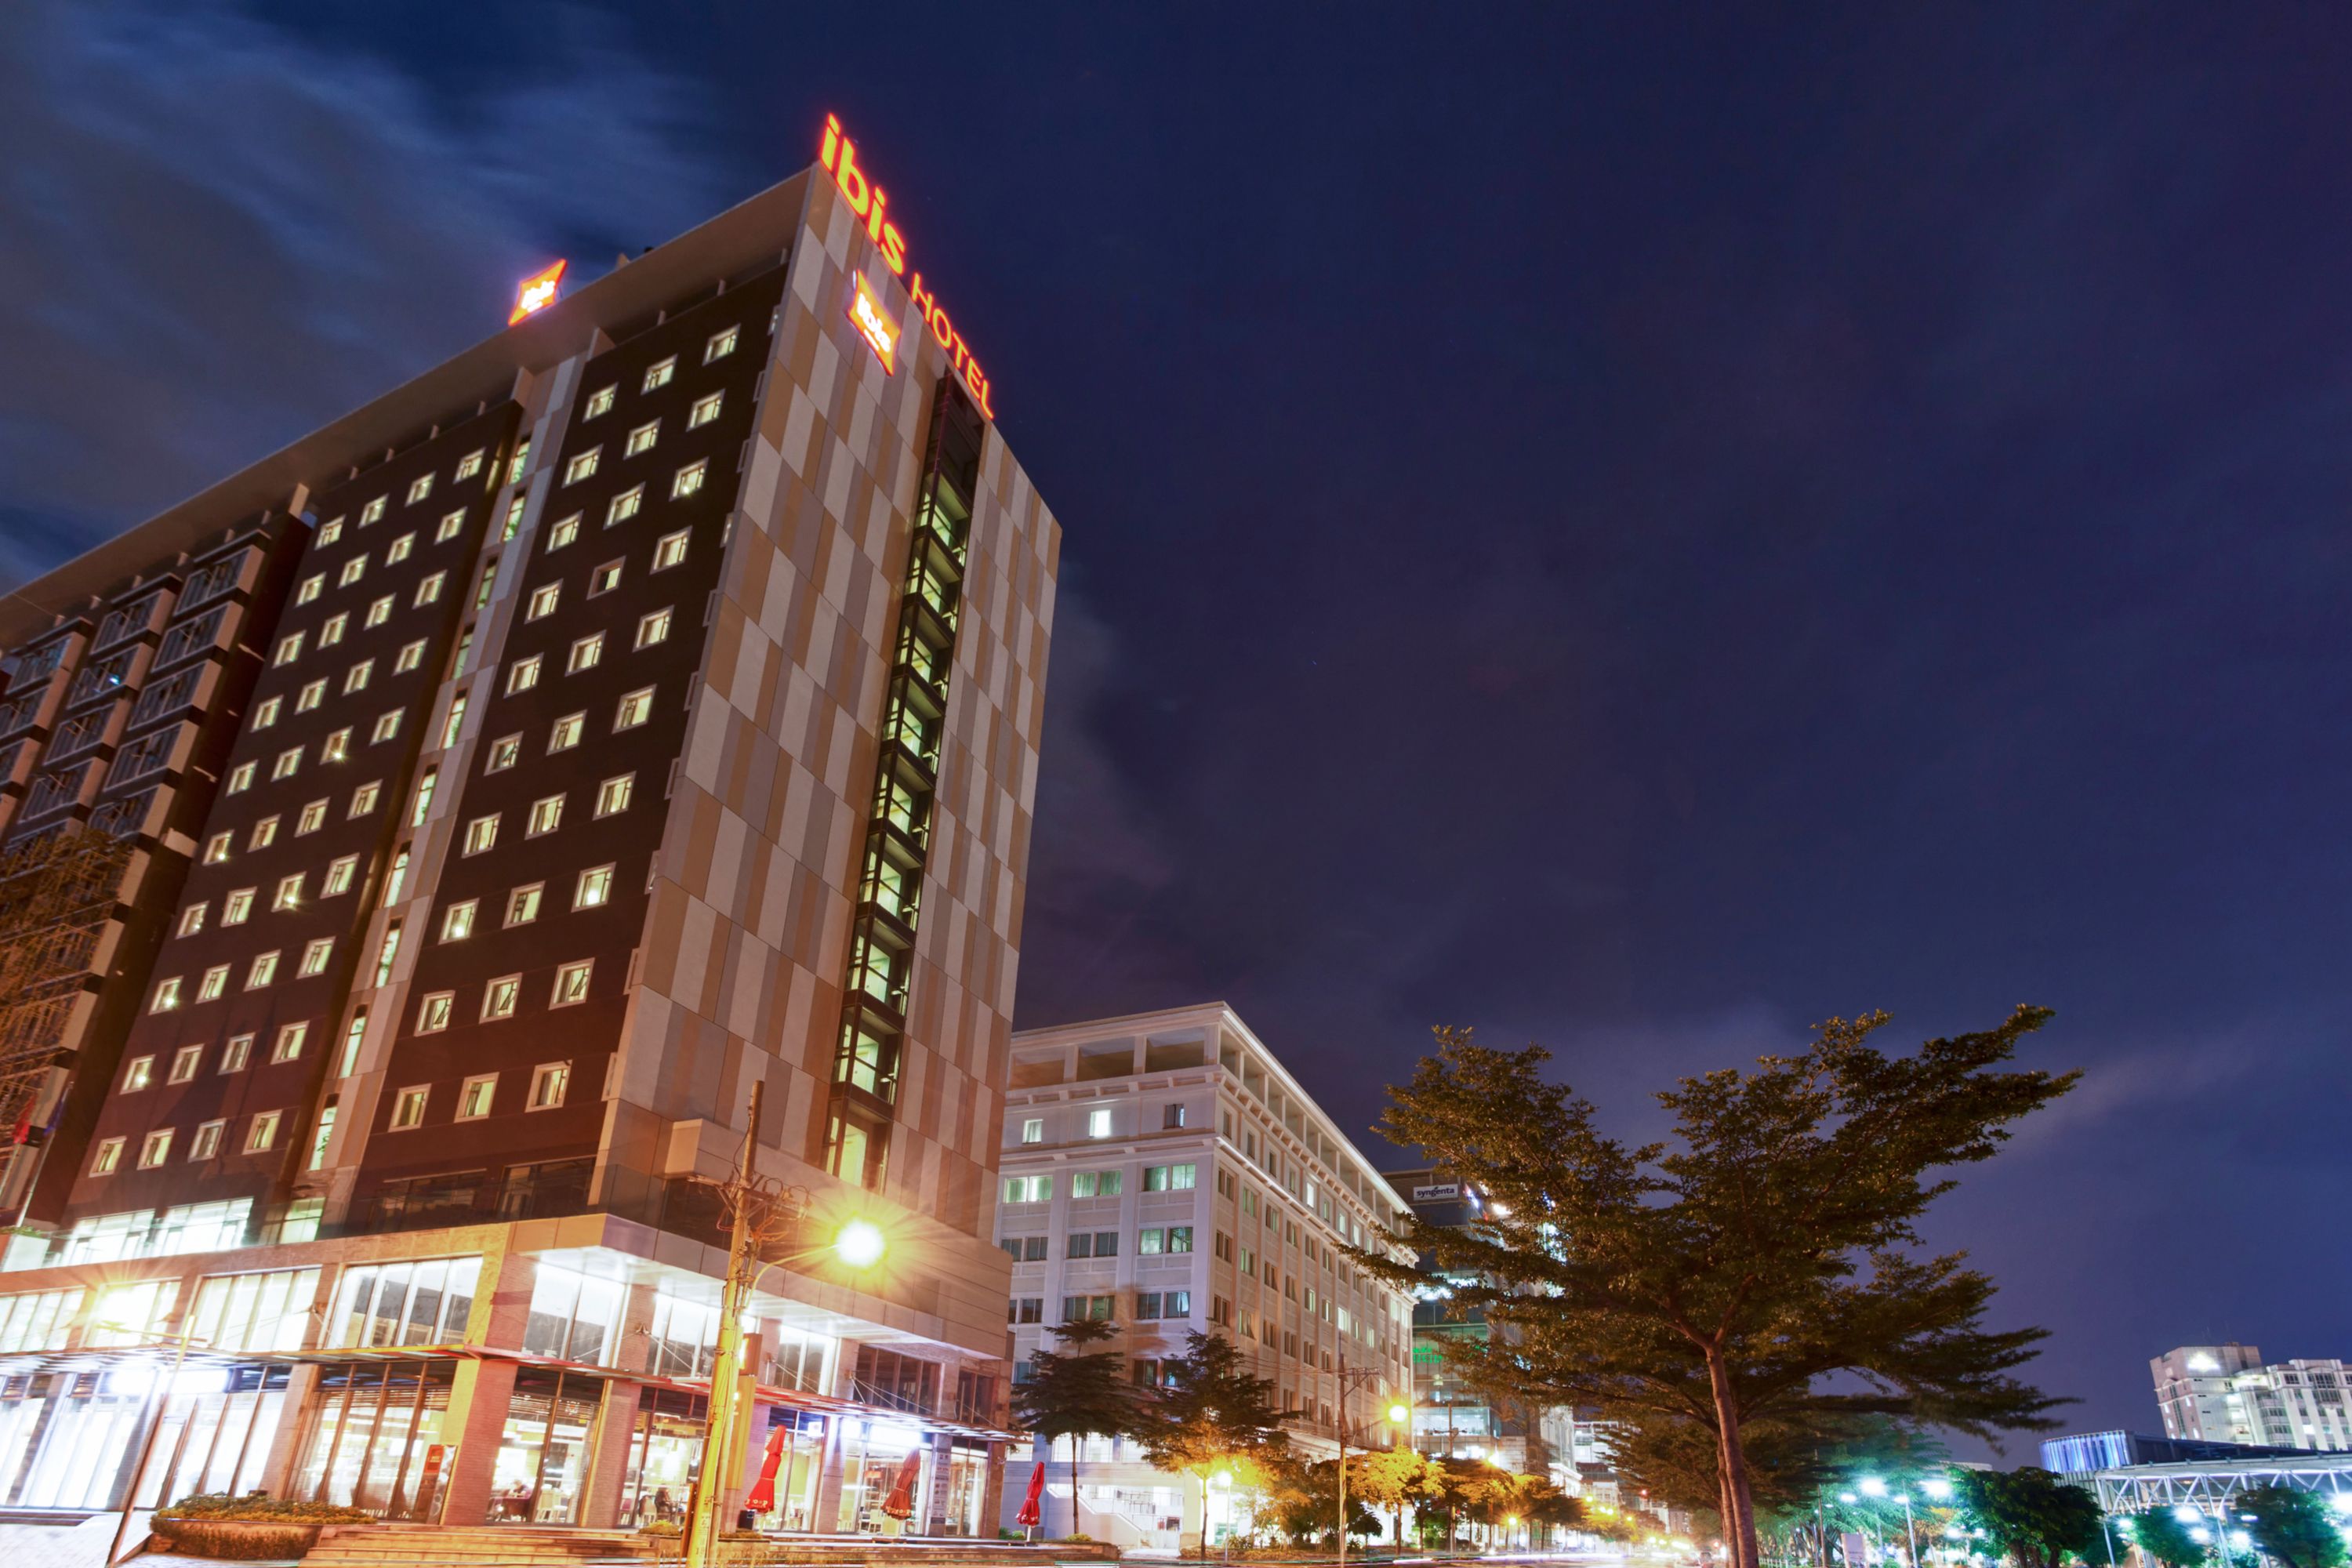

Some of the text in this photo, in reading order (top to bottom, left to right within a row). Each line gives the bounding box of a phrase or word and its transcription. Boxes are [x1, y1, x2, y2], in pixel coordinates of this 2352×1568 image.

[820, 114, 993, 419] ibis HOTEL
[1417, 1187, 1455, 1198] syngenta
